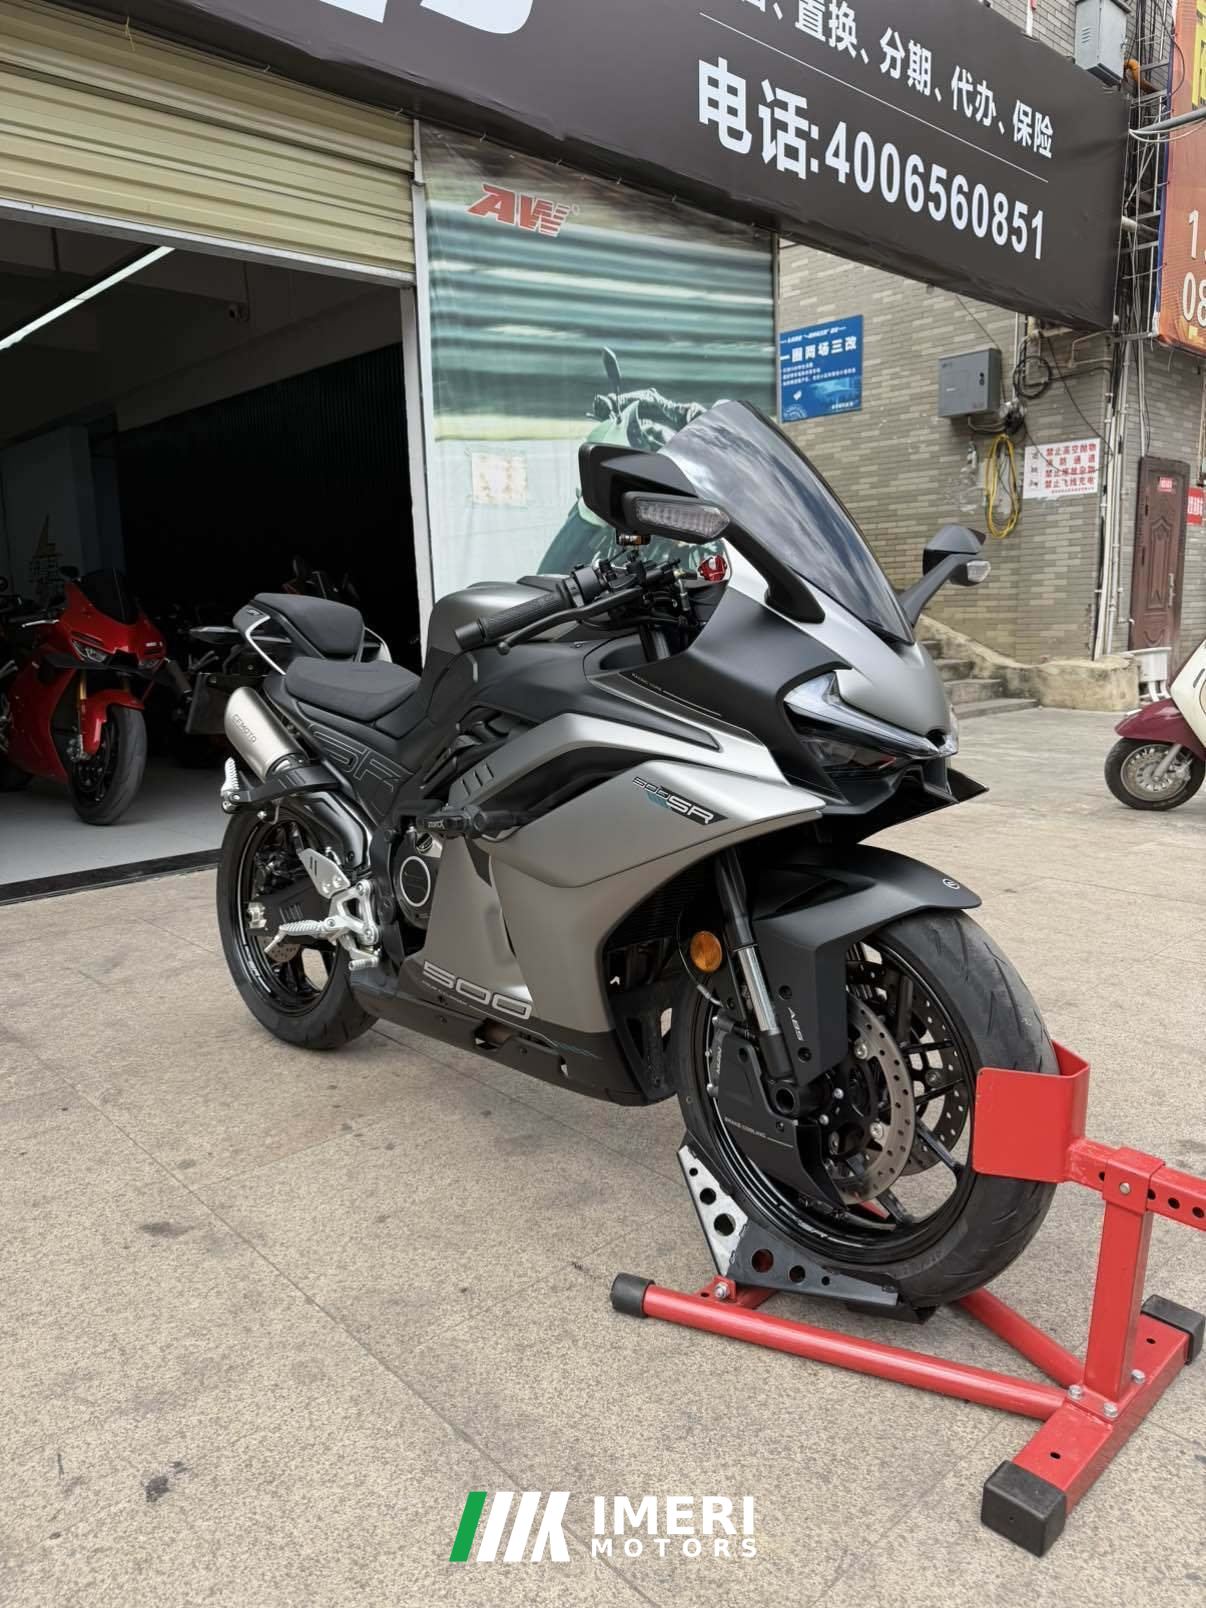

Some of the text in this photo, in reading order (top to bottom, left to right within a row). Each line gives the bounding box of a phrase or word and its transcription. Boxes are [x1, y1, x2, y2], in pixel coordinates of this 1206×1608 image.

[741, 0, 1053, 159] 、置换、分期、代办、保险
[422, 960, 533, 1020] 500
